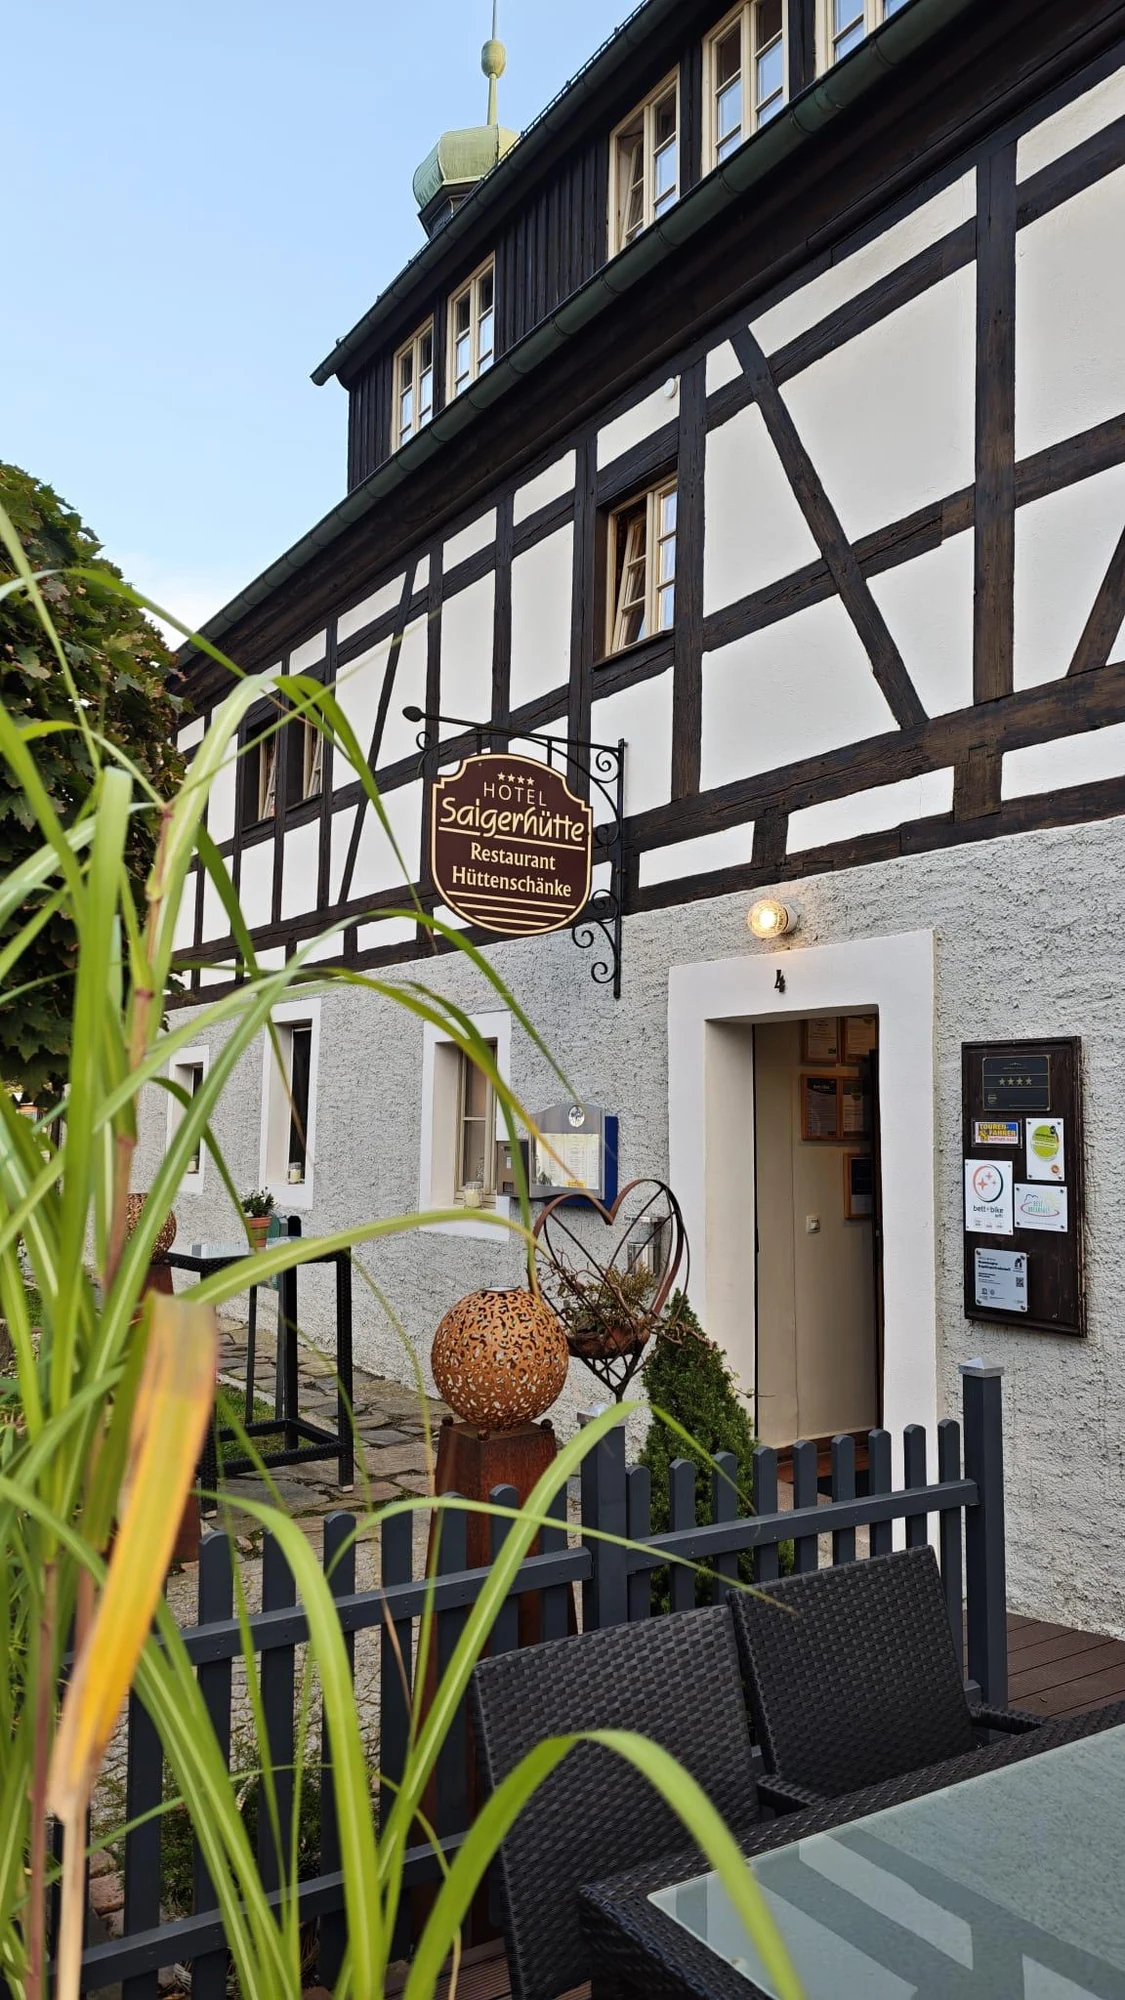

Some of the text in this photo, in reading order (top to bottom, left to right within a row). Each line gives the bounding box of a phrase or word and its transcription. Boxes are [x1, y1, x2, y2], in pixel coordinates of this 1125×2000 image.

[483, 781, 546, 806] HOTEL
[440, 797, 585, 841] Saigerhütte
[471, 842, 556, 870] Restaurant
[452, 866, 571, 896] Hüttenschänke
[774, 969, 786, 993] 4
